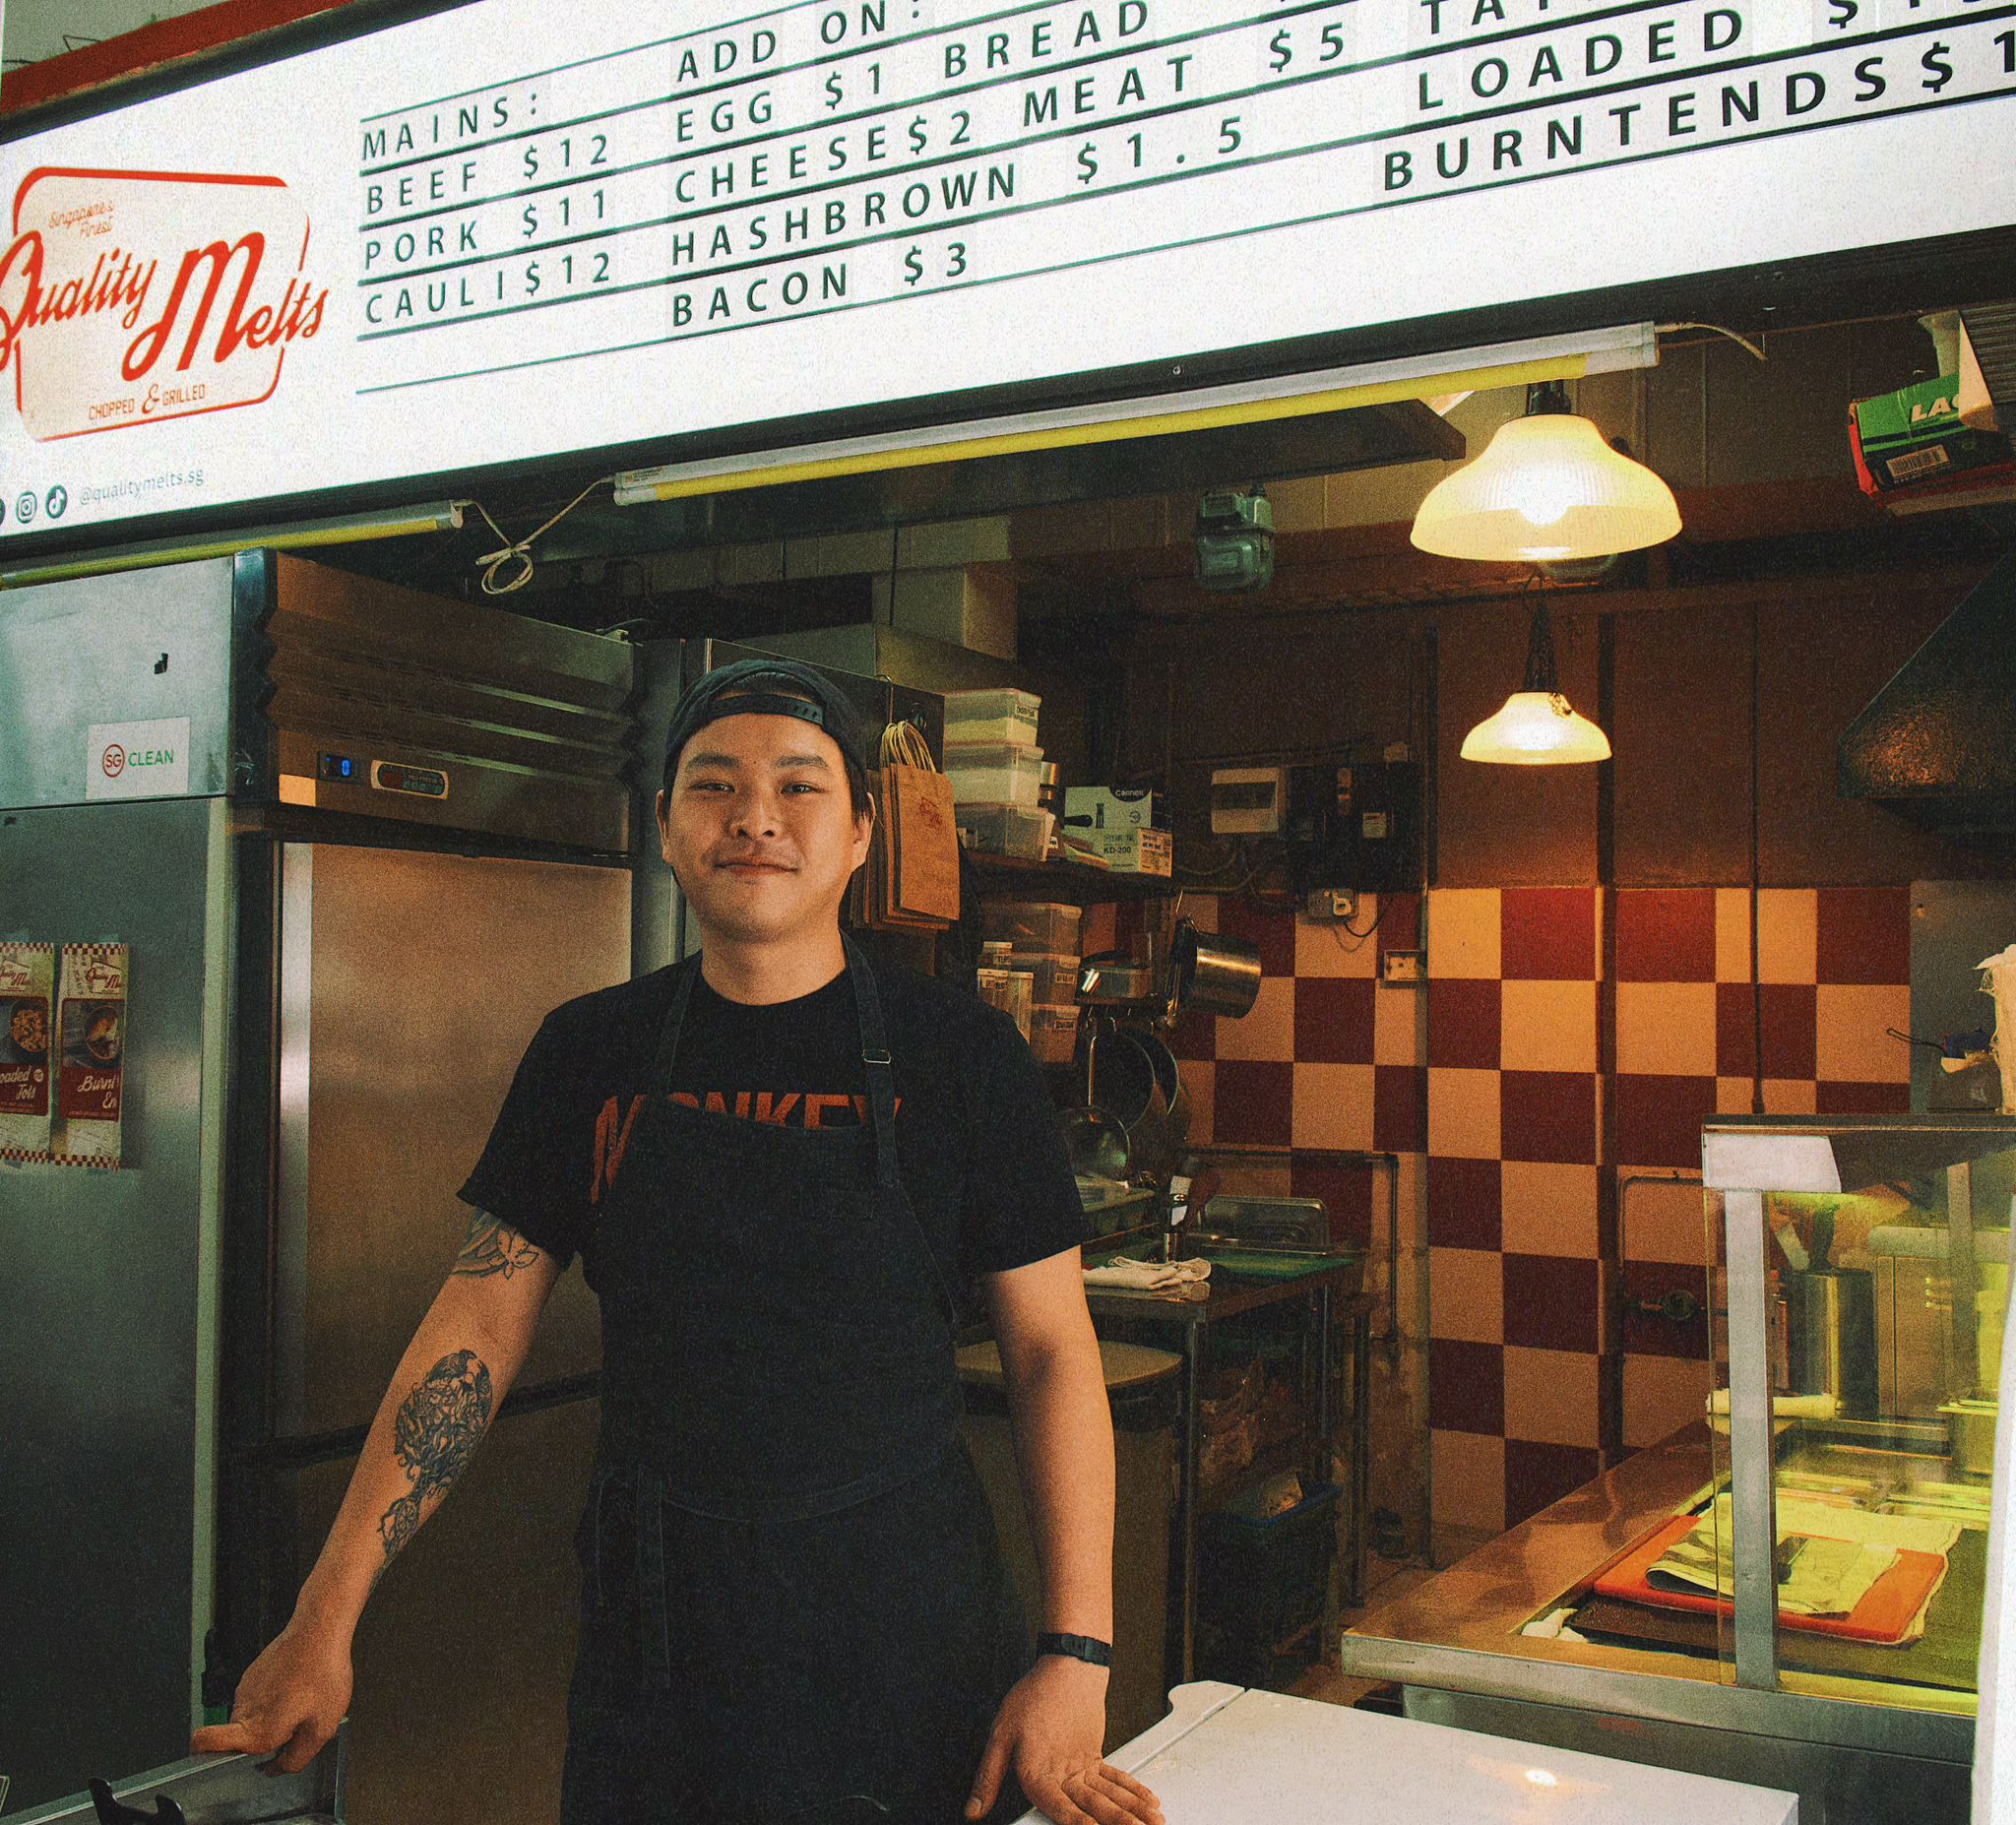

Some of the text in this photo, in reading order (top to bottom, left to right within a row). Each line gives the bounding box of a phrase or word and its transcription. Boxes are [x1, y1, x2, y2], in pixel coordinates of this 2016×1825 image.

[677, 31, 778, 83] ADD
[677, 0, 1148, 144] EGG $1 BREAD
[1024, 55, 1193, 127] MEAT
[1269, 23, 1345, 73] $5
[1418, 9, 1743, 112] LOADED
[363, 93, 537, 159] MAINS:
[366, 135, 607, 215] BEEF $12
[672, 117, 1241, 266] HASHBROWN $1.5
[366, 190, 605, 270] PORK $11
[0, 229, 329, 382] Quality Melts
[673, 242, 967, 328] BACON $3
[88, 398, 135, 420] CHOPPED
[162, 384, 206, 407] GRILLED
[80, 469, 205, 505] @qualitymelts.sg
[105, 749, 174, 768] SG CLEAN
